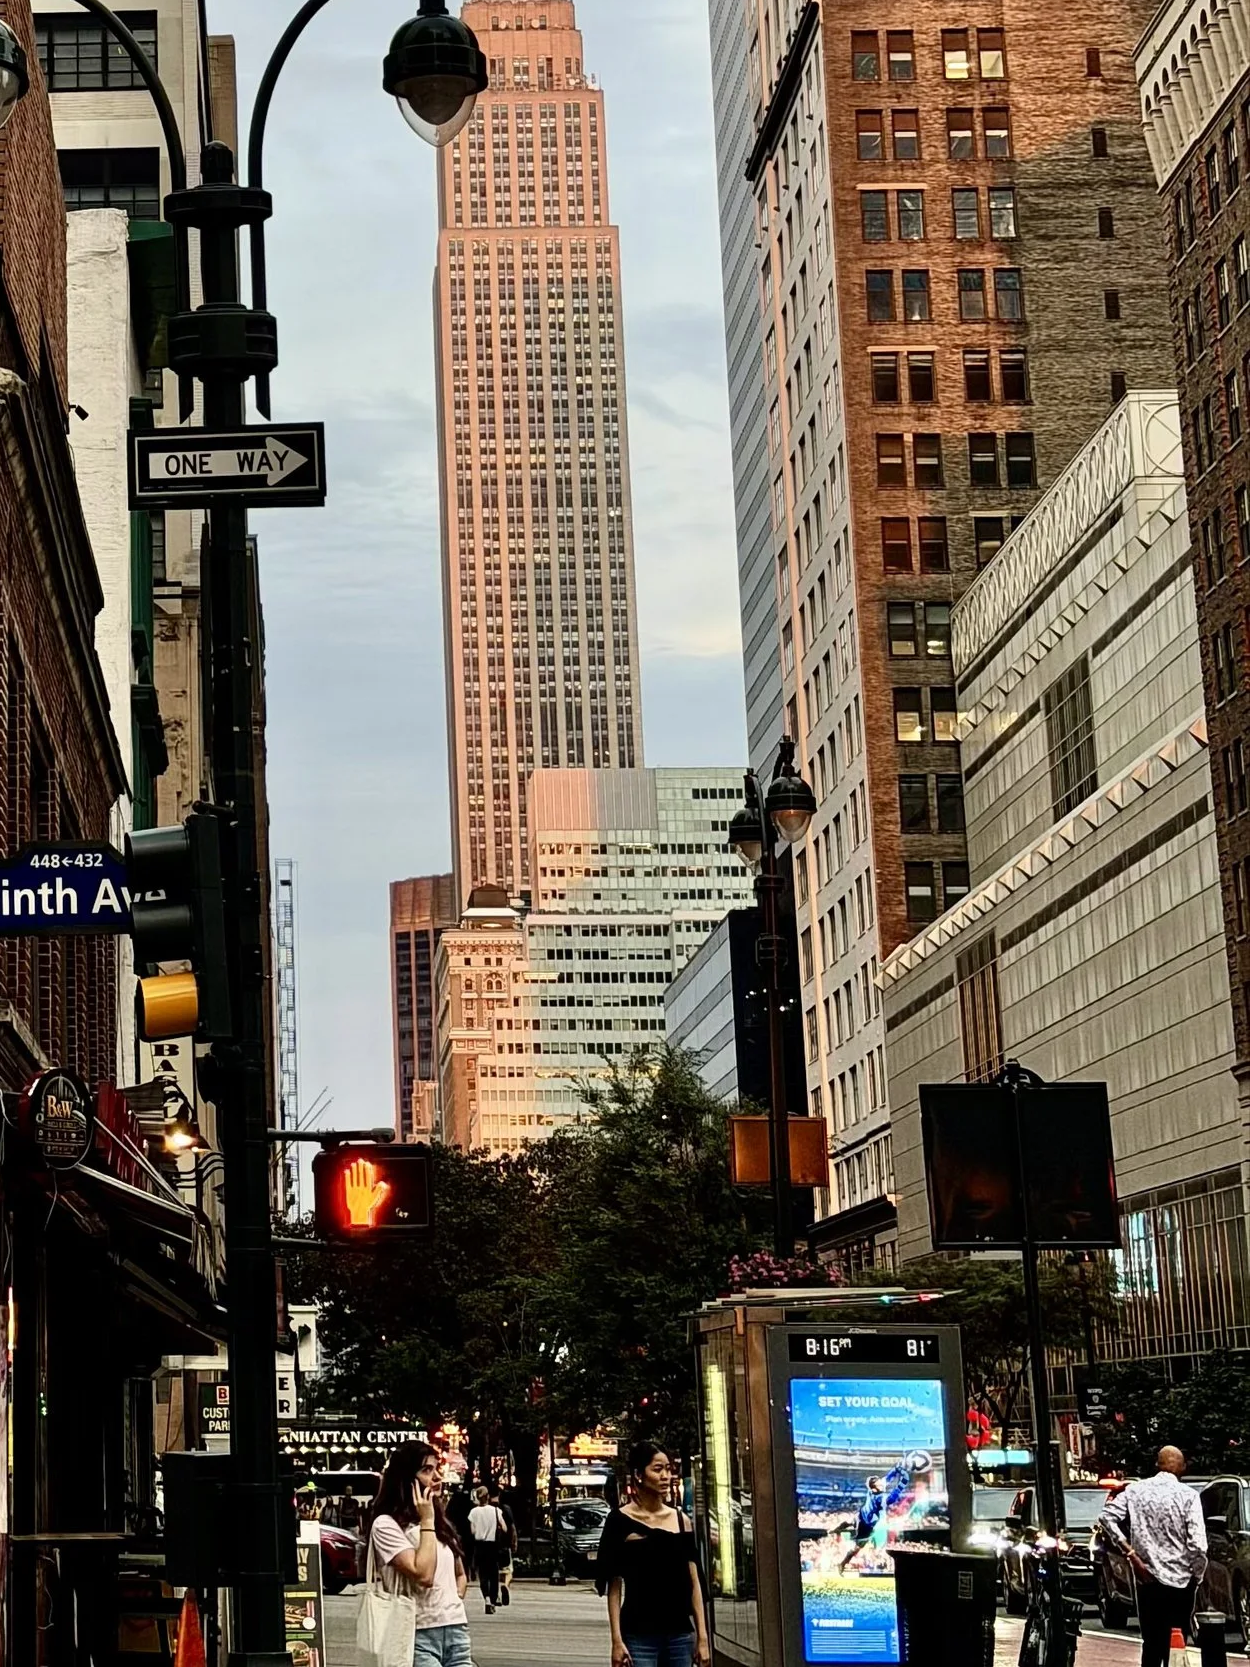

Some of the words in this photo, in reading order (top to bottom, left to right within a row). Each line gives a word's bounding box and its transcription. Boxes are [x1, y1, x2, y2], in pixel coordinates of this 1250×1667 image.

[165, 453, 212, 476] ONE
[236, 450, 289, 473] WAY
[30, 854, 60, 868] 448
[74, 853, 103, 867] 432
[47, 1095, 73, 1119] B&W
[818, 1396, 842, 1407] SET
[844, 1396, 879, 1407] YOUR
[881, 1396, 914, 1407] GOAL
[203, 1407, 230, 1419] CUST
[209, 1420, 230, 1432] PAR
[279, 1431, 360, 1443] ANHATTAN
[367, 1431, 428, 1443] CENTER
